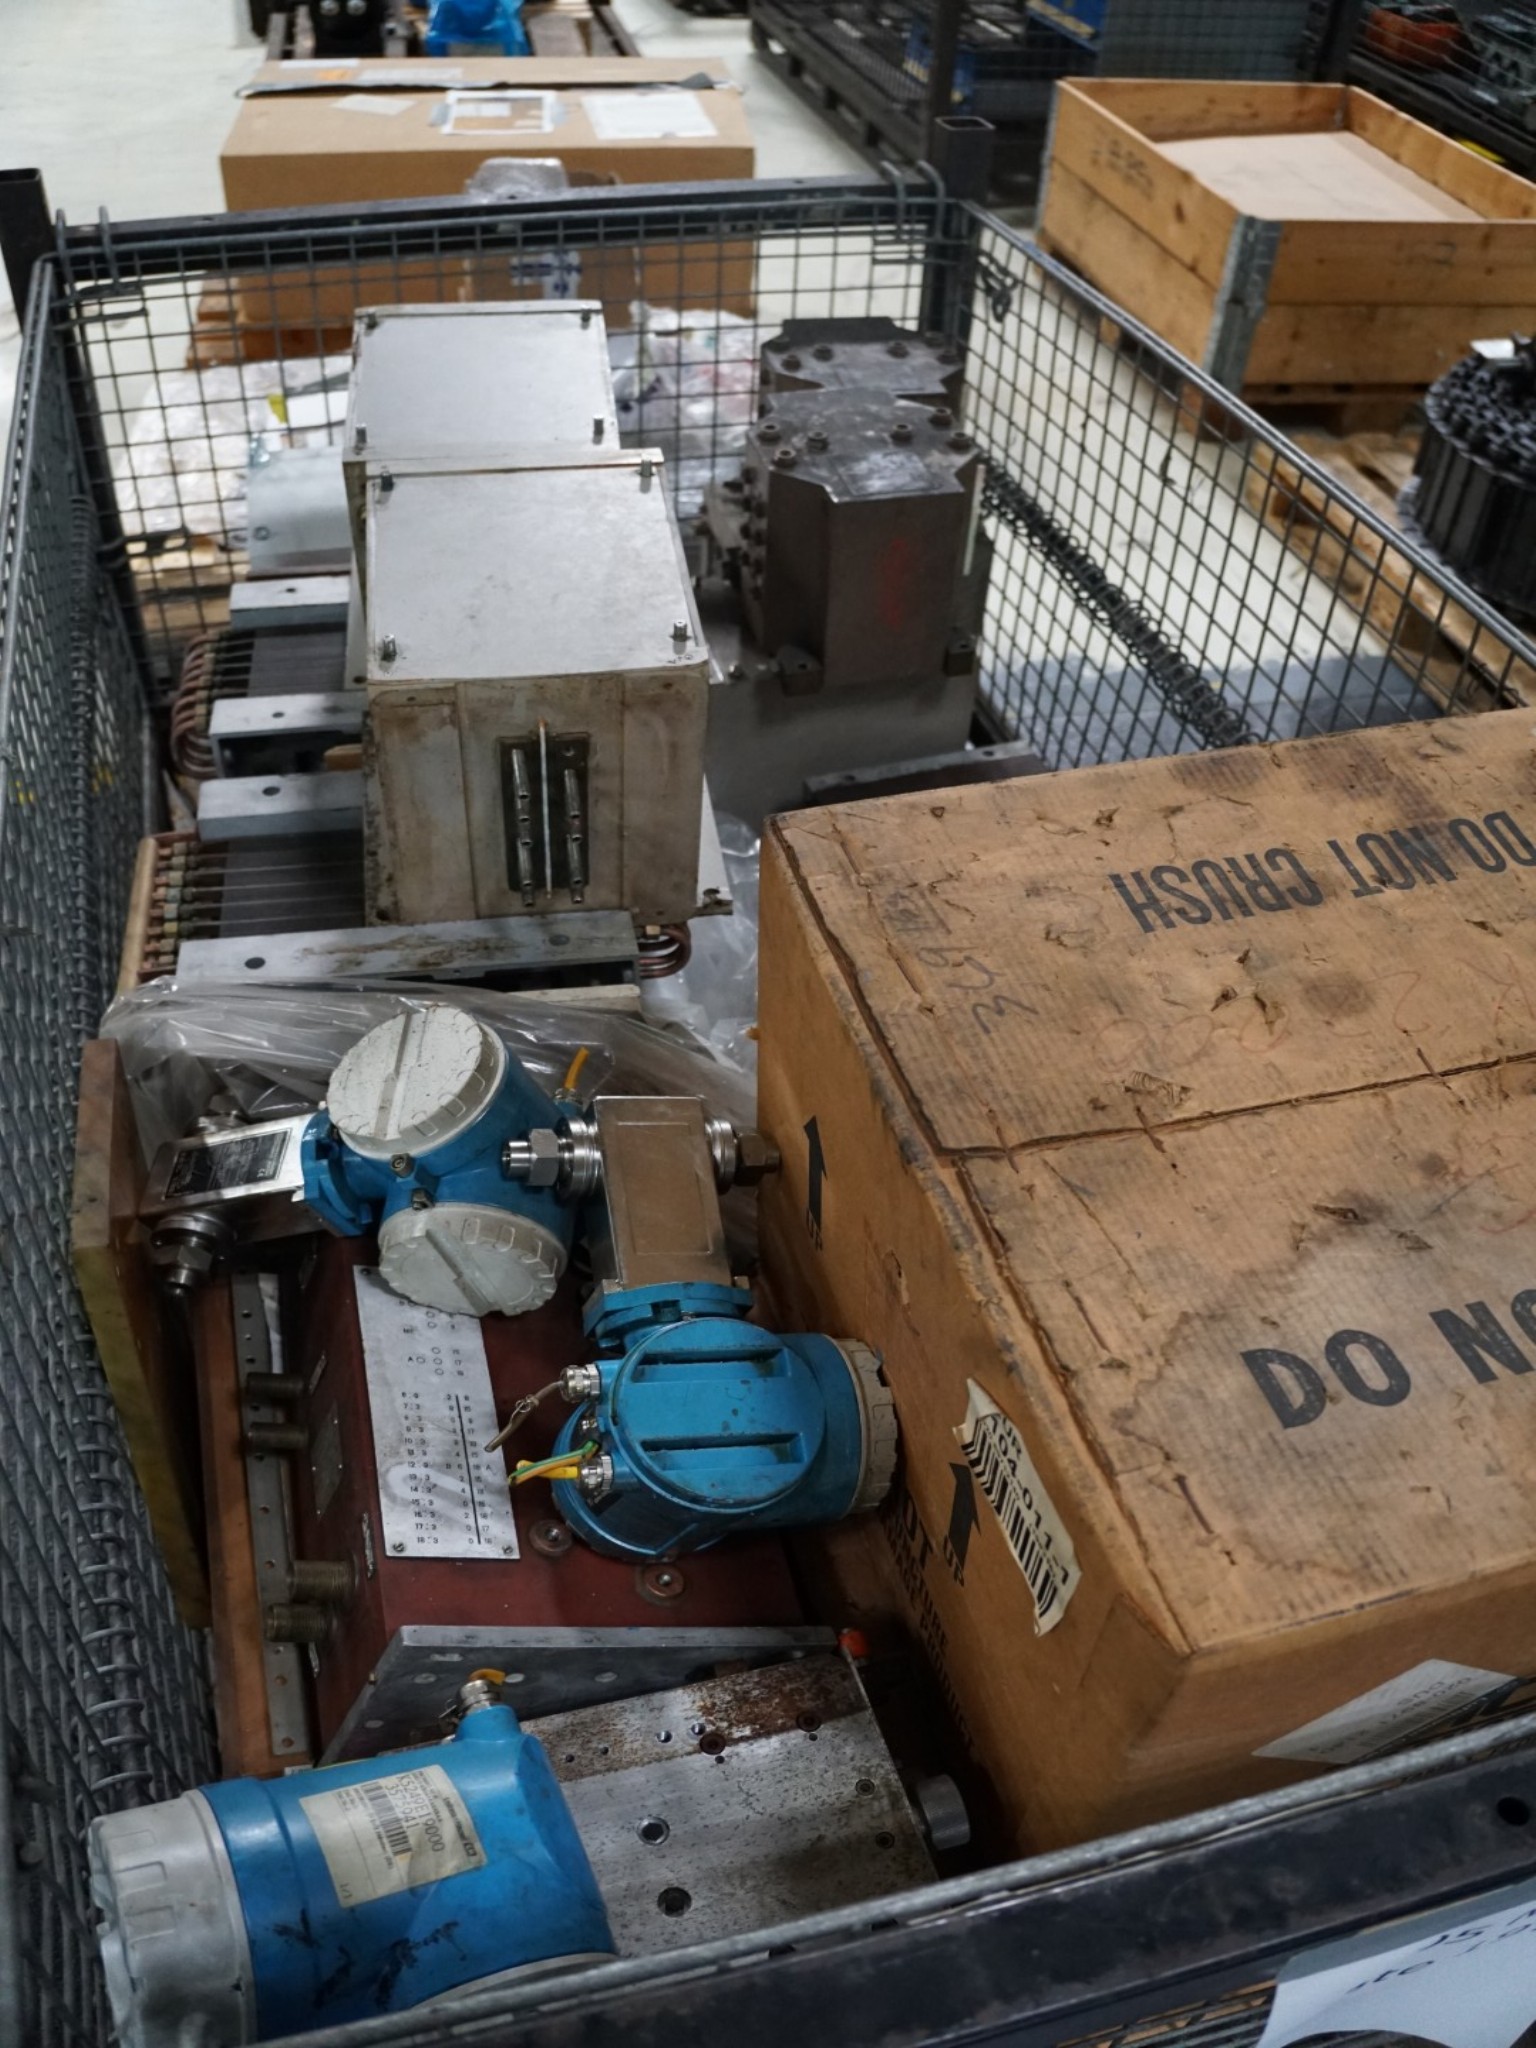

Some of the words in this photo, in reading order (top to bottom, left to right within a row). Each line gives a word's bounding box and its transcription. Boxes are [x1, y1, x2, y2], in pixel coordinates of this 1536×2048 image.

[1107, 847, 1324, 934] CRUSH
[1327, 826, 1457, 898] NOT
[1240, 1329, 1411, 1429] DO
